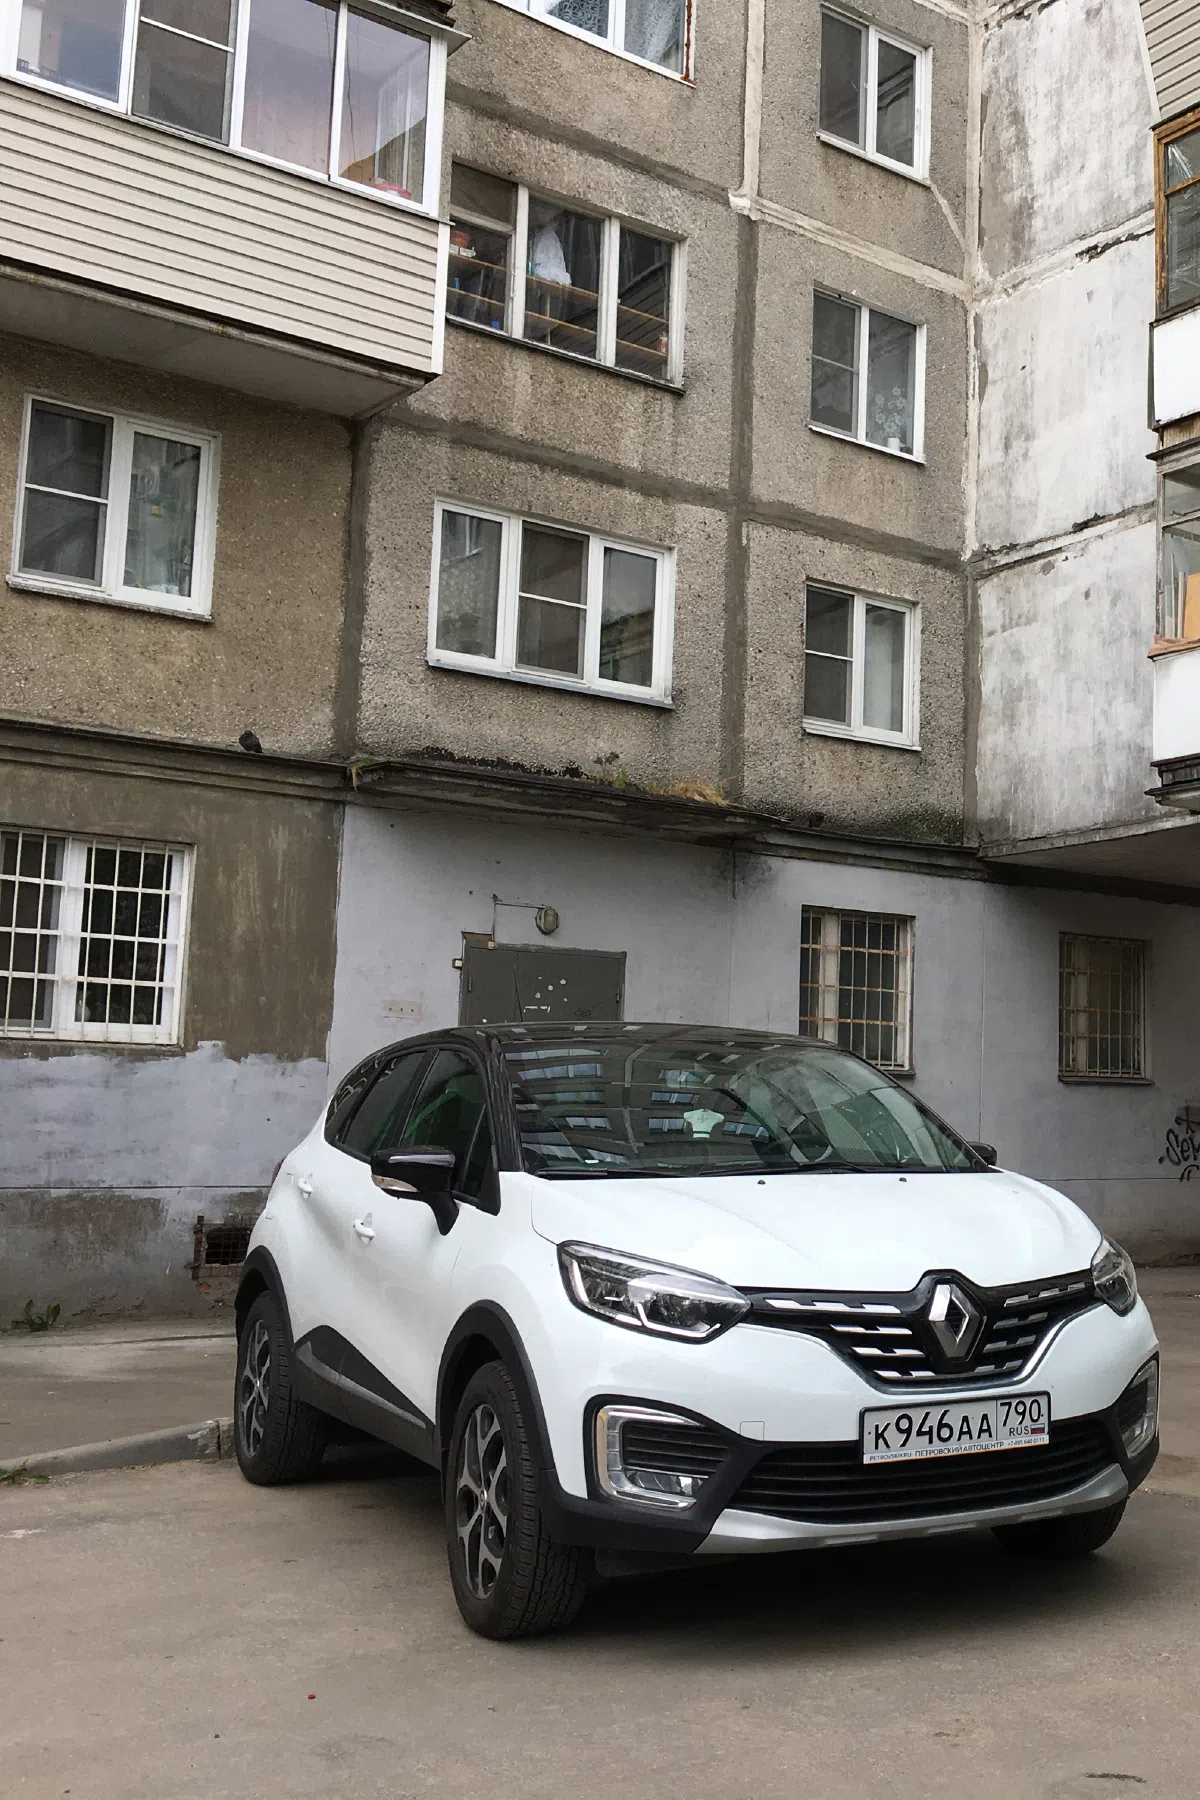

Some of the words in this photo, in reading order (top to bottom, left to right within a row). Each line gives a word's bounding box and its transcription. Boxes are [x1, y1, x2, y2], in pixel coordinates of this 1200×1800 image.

[1000, 1399, 1042, 1427] 790
[1009, 1425, 1030, 1436] RUS
[915, 1445, 962, 1457] ПЕТРОВСКИЙ
[963, 1441, 1004, 1452] АВТОЦЕНТР
